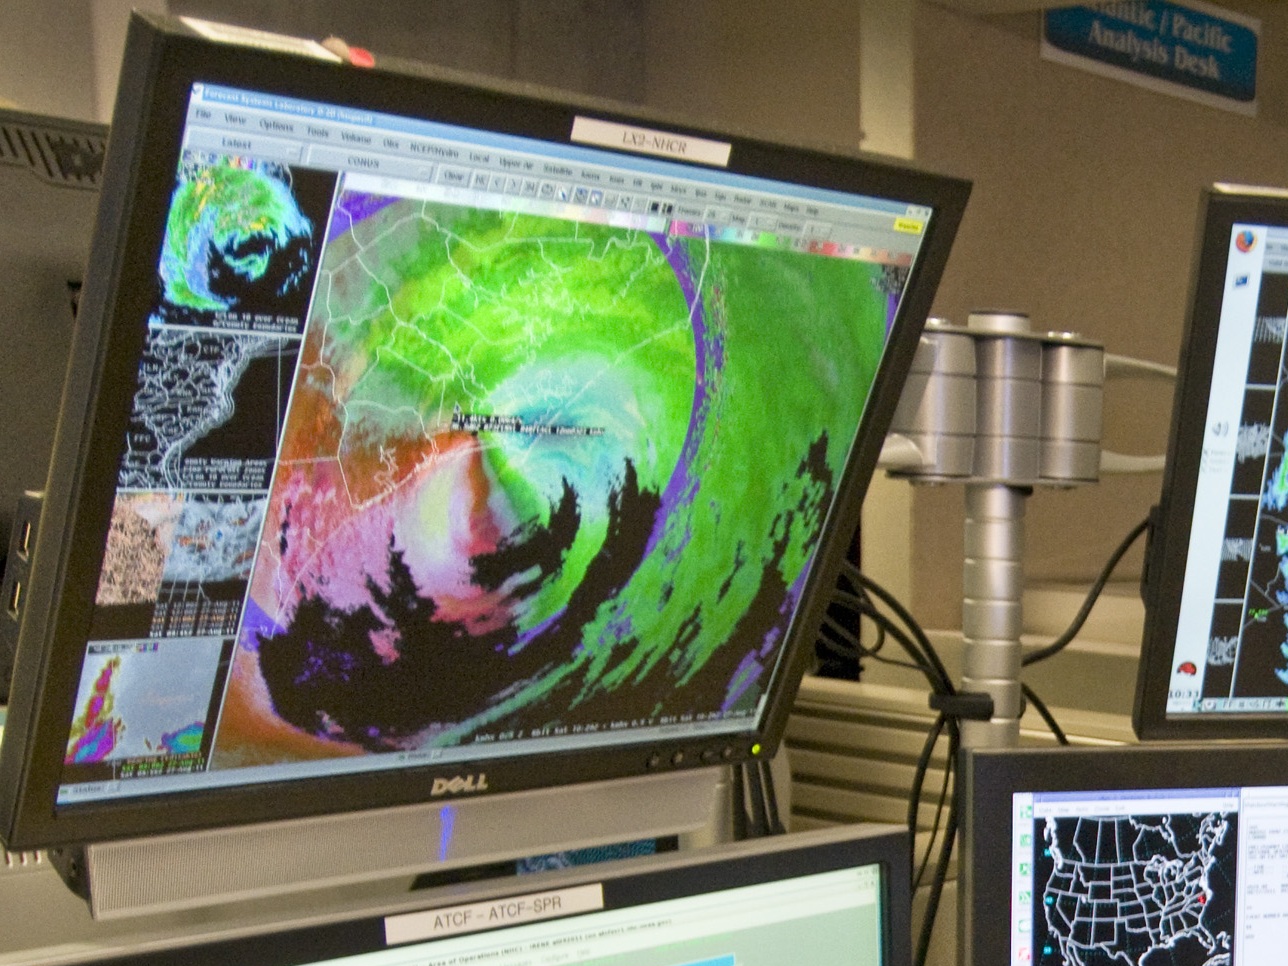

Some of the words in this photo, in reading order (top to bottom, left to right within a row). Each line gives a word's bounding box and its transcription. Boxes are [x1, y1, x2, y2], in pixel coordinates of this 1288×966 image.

[1088, 20, 1168, 64] Analysis
[1174, 45, 1221, 80] Desk
[1173, 12, 1232, 53] Pacific
[621, 130, 688, 154] LX2-NHCR
[430, 772, 489, 797] DELL
[433, 909, 473, 930] ATCF
[488, 895, 562, 921] ATCF-SPR
